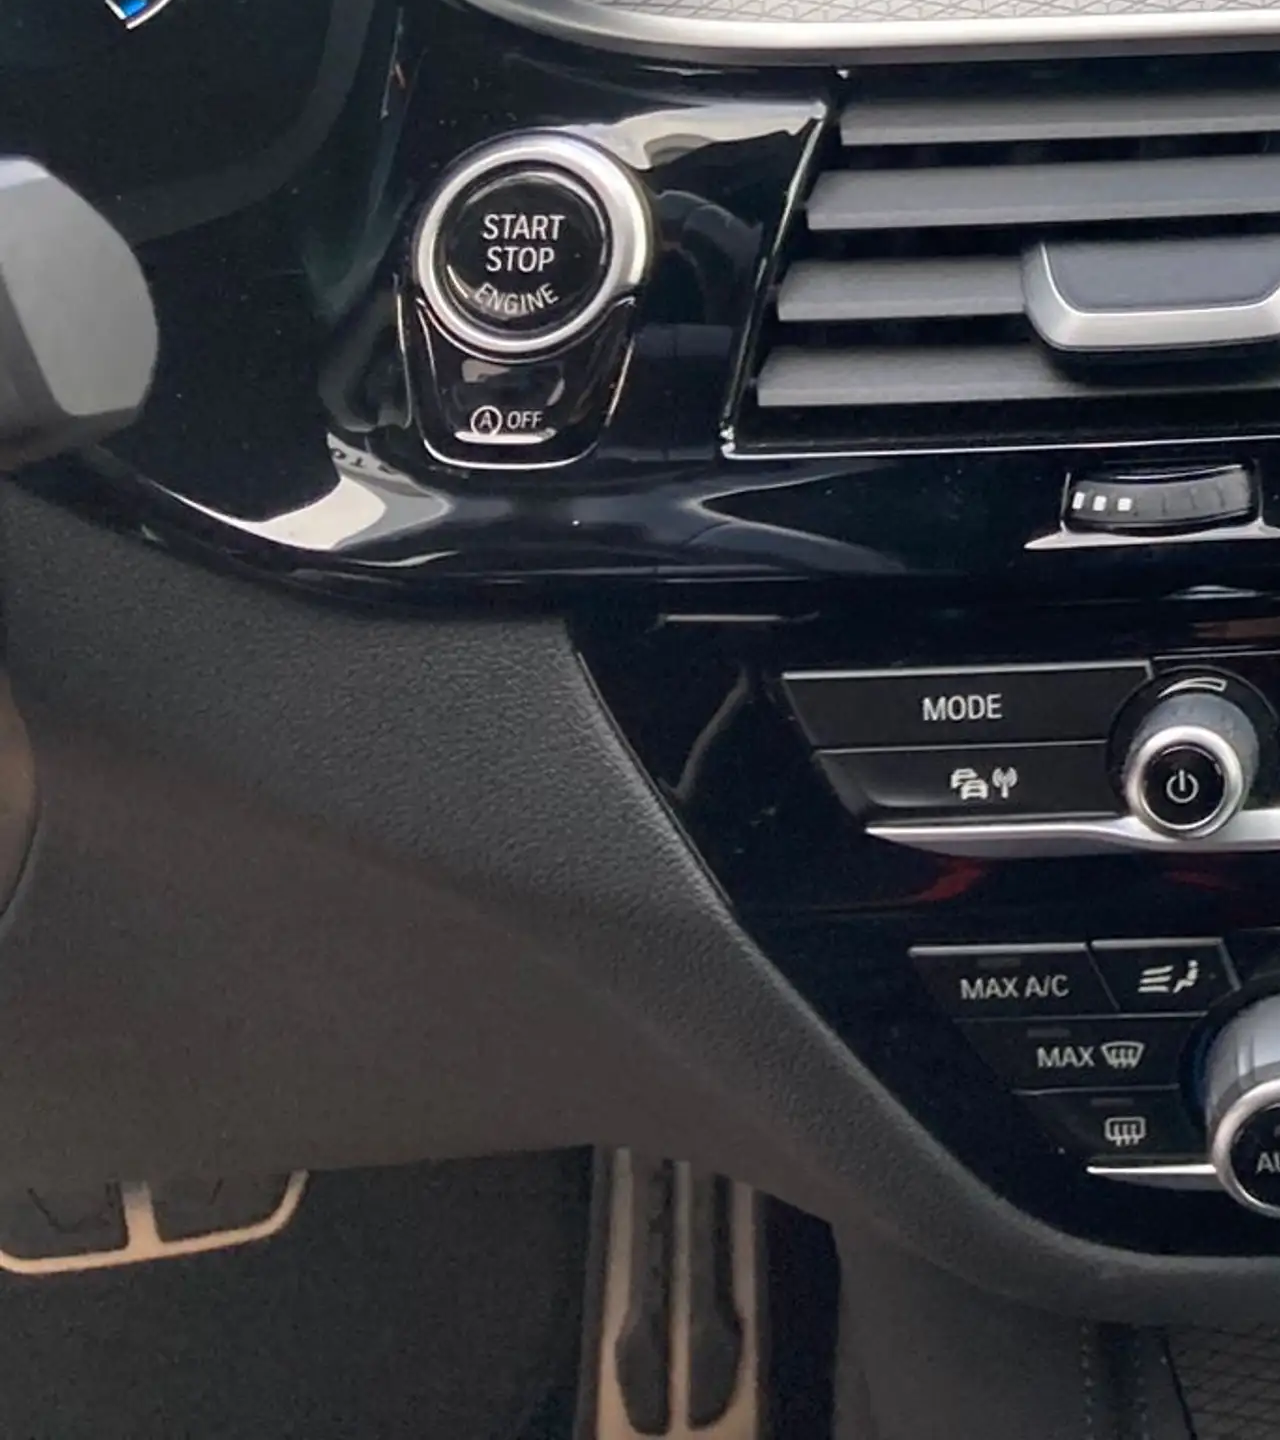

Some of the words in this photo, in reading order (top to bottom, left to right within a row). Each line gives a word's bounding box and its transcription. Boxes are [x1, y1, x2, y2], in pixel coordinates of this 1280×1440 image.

[483, 214, 564, 241] START
[486, 246, 555, 273] STOP
[473, 282, 560, 312] ENGINE
[507, 411, 543, 430] OFF
[922, 694, 1003, 721] MODE
[961, 978, 1019, 1000] MAX
[1025, 973, 1069, 997] A/C
[1036, 1046, 1095, 1068] MAX
